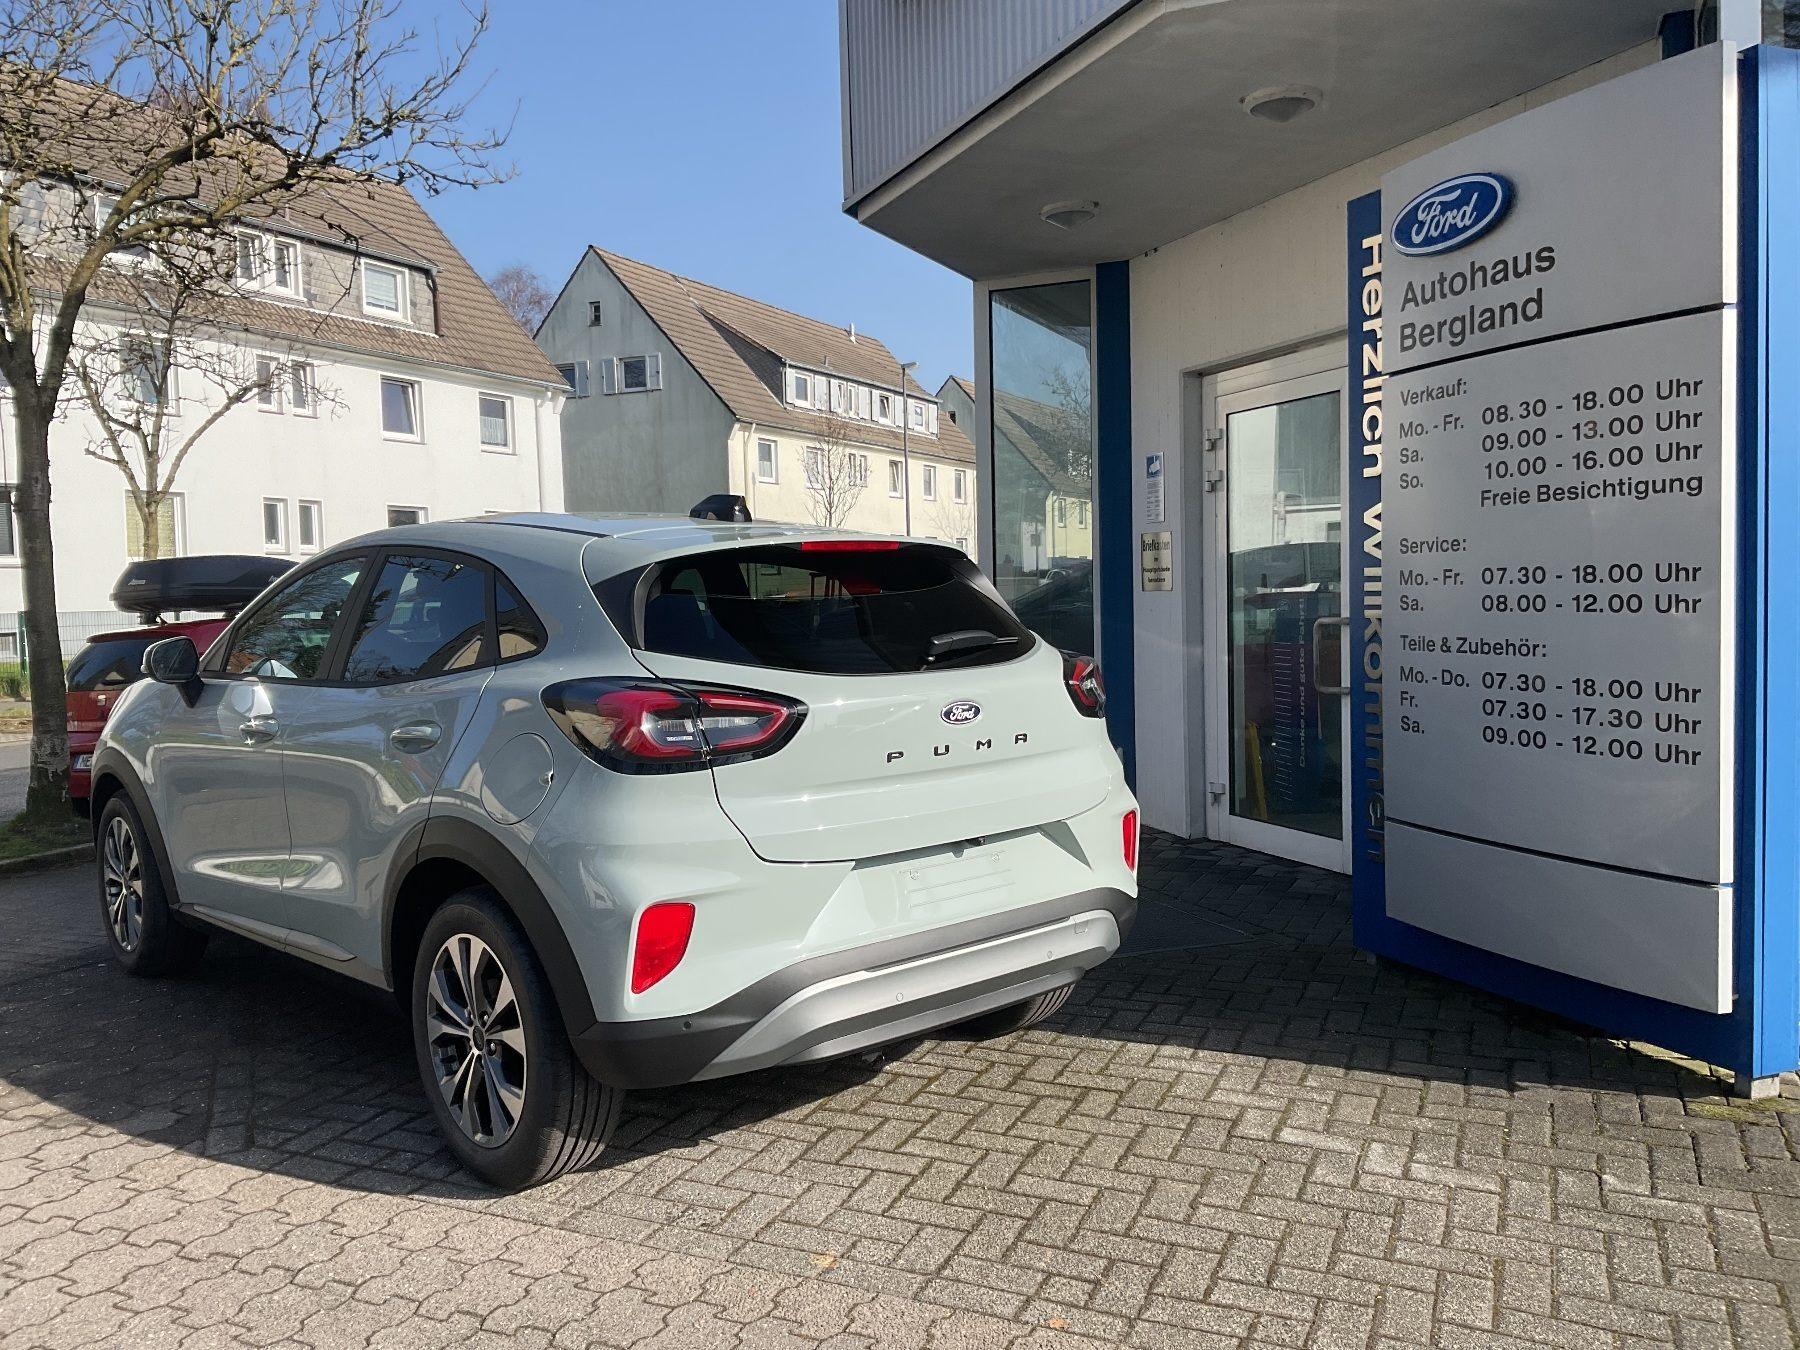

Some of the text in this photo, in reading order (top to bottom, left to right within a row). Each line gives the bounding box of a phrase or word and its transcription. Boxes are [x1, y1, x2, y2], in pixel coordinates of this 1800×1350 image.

[1411, 190, 1478, 243] Ford
[1401, 245, 1555, 313] Autohaus
[1400, 287, 1542, 353] Bergland
[1400, 378, 1466, 406] Verkauf:
[1482, 399, 1546, 425] 08.30
[1572, 384, 1643, 411] 18.00
[1656, 378, 1703, 400] Uhr
[1400, 448, 1423, 464] Sa.
[1482, 428, 1546, 452] 09.00
[1572, 415, 1643, 441] 13.00
[1656, 410, 1703, 431] Uhr
[1400, 473, 1423, 489] So.
[1485, 456, 1546, 479] 10.00
[1572, 446, 1643, 470] 16.00
[1656, 442, 1702, 463] Uhr
[1481, 476, 1702, 507] Freie Besichtigung
[1400, 537, 1466, 554] Service:
[1482, 566, 1546, 585] 07.30
[1572, 563, 1642, 583] 18.00
[1656, 563, 1701, 582] Uhr
[1400, 595, 1423, 611] Sa.
[1482, 594, 1546, 612] 08.00
[1572, 594, 1642, 613] 12.00
[1655, 594, 1701, 613] Uhr
[1400, 635, 1546, 657] Teile & Zubehör:
[1482, 672, 1545, 693] 07.30
[1572, 678, 1642, 699] 18.00
[1655, 682, 1701, 703] Uhr
[1401, 691, 1418, 707] Fr.
[1482, 699, 1546, 721] 07.30
[1572, 707, 1642, 729] 17.30
[1655, 713, 1701, 734] Uhr
[886, 732, 1028, 763] PUMA
[1401, 716, 1424, 734] Sa.
[1483, 726, 1546, 749] 09.00
[1572, 736, 1642, 759] 12.00
[1655, 743, 1701, 765] Uhr
